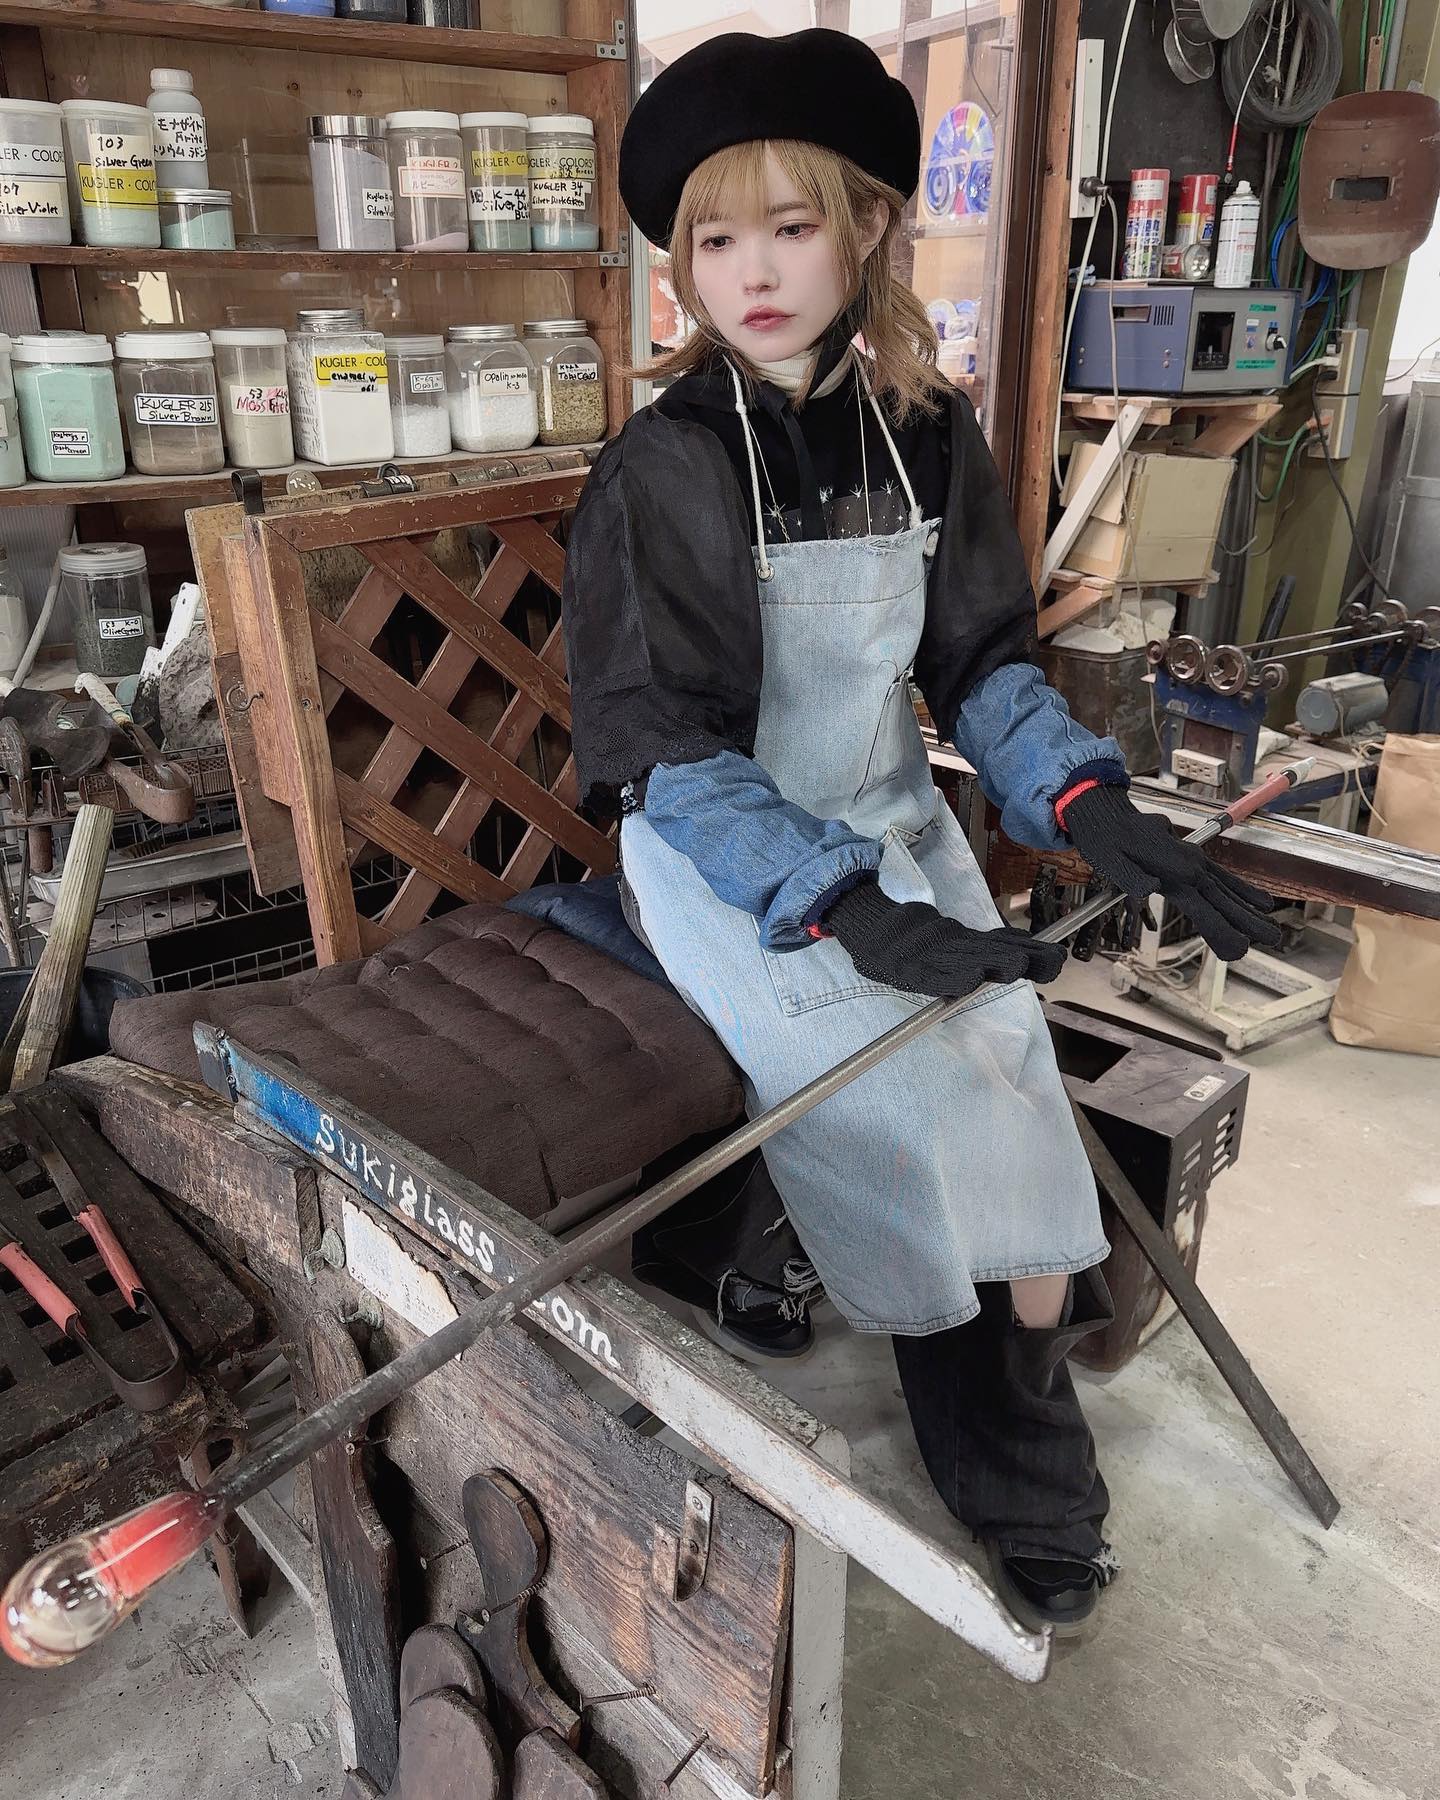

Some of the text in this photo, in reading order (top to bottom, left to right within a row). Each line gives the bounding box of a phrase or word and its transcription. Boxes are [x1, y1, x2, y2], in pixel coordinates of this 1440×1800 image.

[97, 136, 124, 151] 103
[473, 156, 510, 170] KUGLER
[81, 176, 125, 190] KUGLER
[533, 181, 567, 192] KUGLER
[481, 200, 516, 212] Silver
[319, 357, 358, 368] KUGLER
[139, 398, 197, 412] KUGLER
[148, 410, 212, 422] Silver Brown
